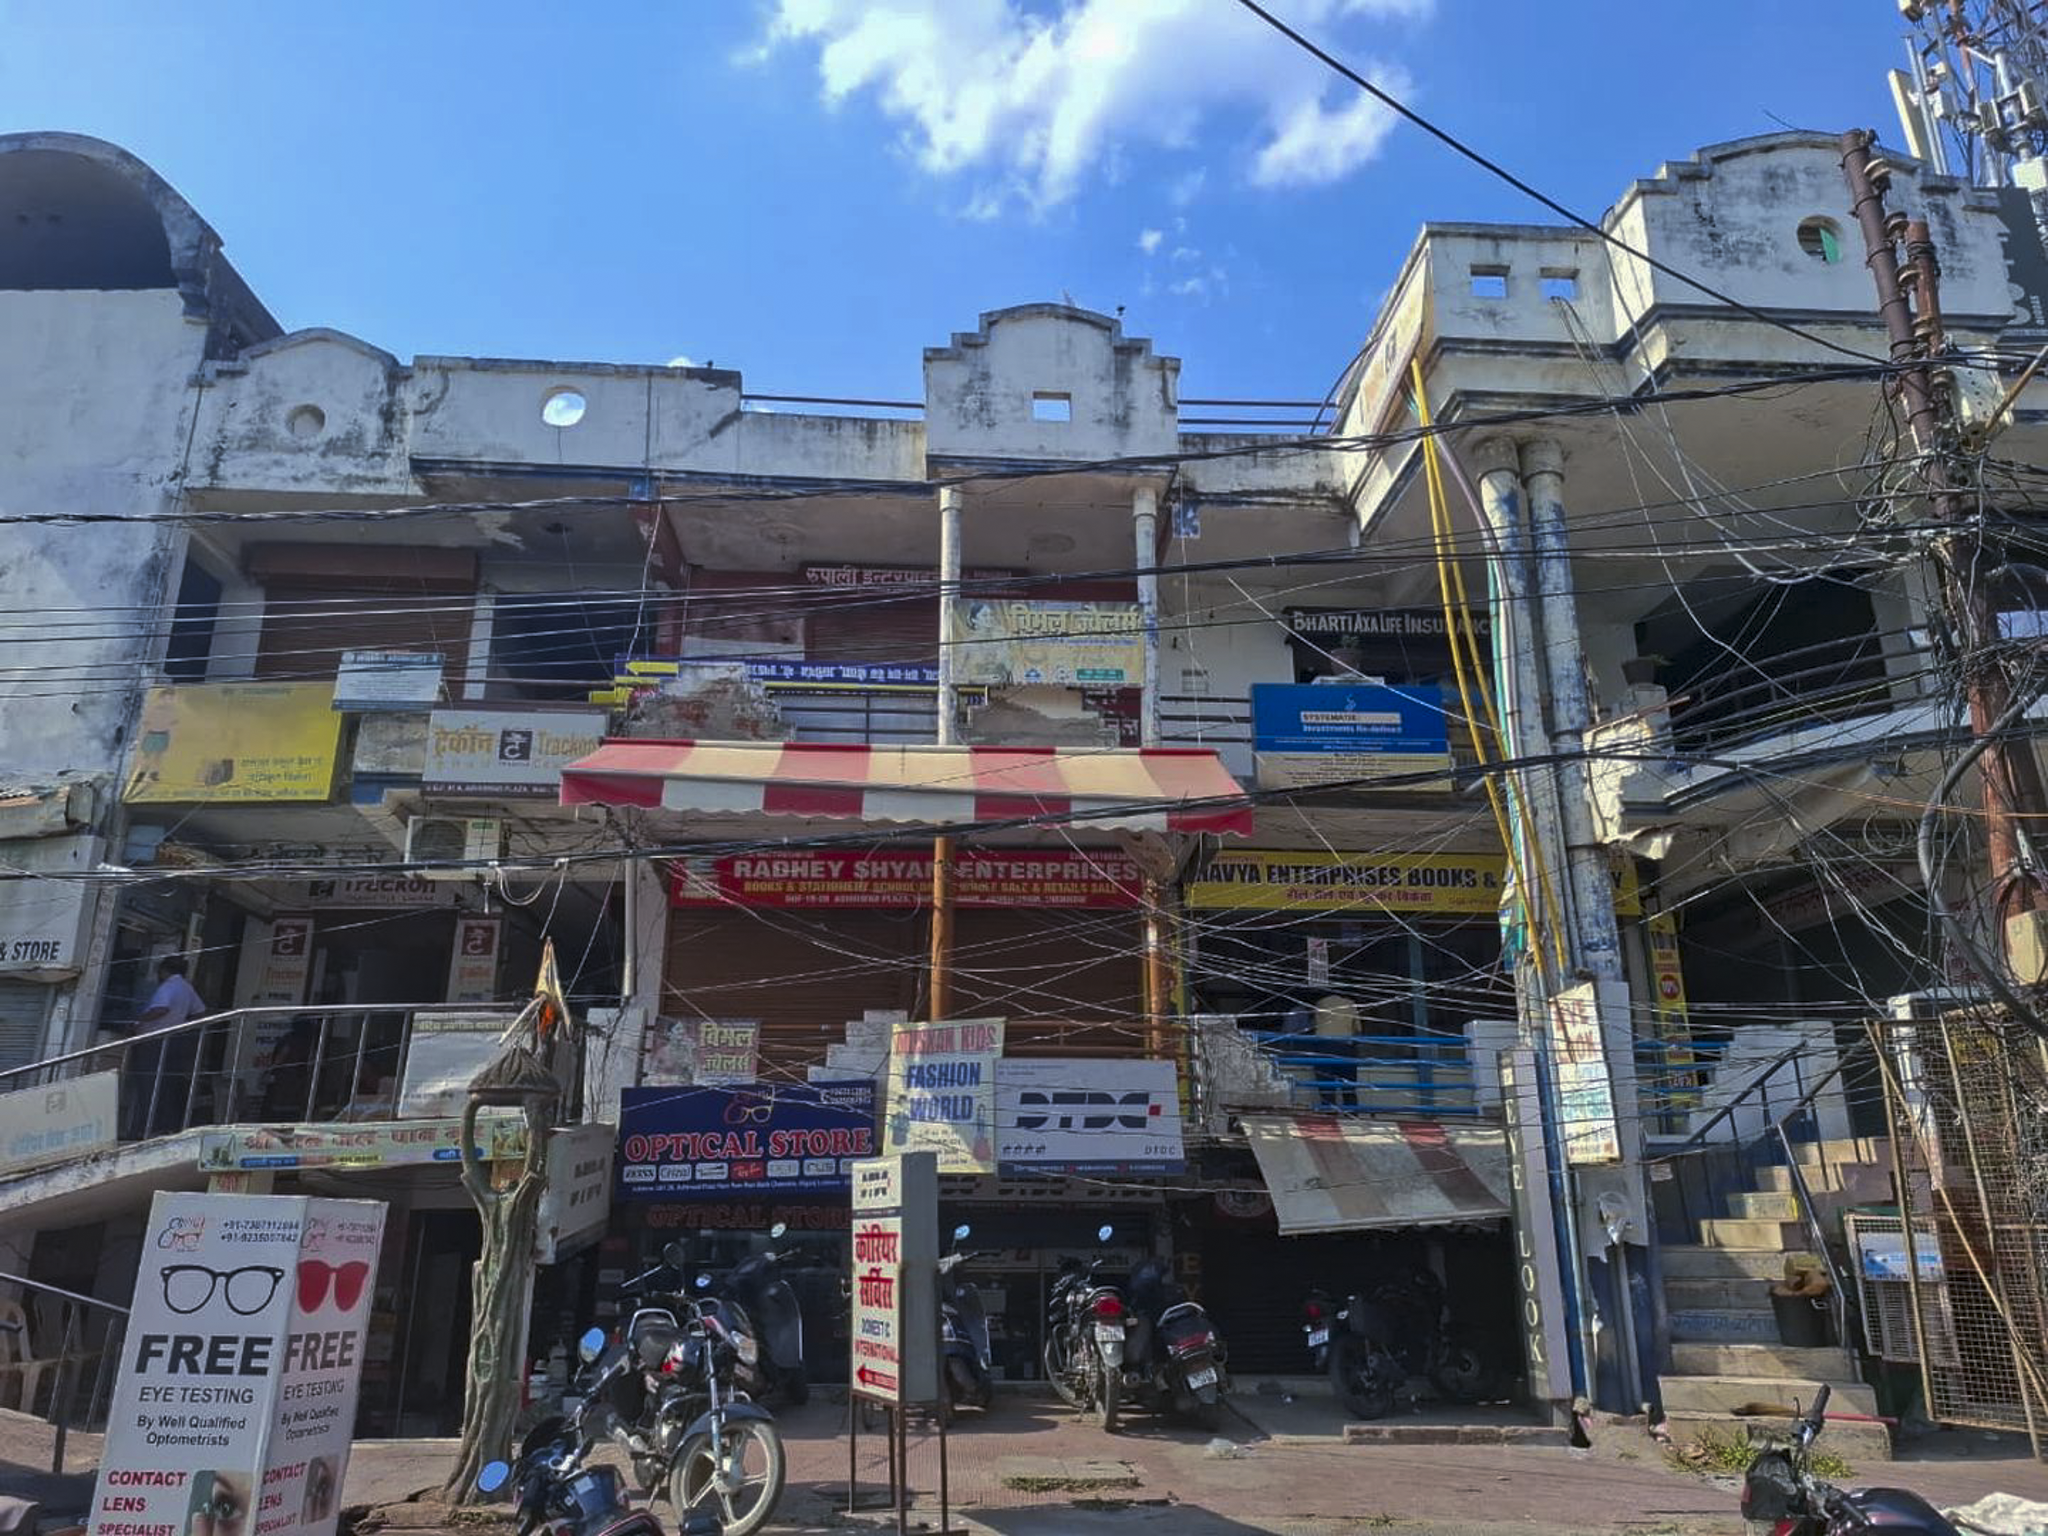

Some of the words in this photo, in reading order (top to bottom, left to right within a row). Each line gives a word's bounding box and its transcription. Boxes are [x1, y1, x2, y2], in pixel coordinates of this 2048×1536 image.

[1294, 611, 1351, 631] BHARTI
[1353, 613, 1378, 633] AXA
[1380, 613, 1402, 632] LIFE
[733, 860, 845, 879] RADHEY
[955, 861, 1139, 881] ENTERPRISES
[1267, 865, 1400, 886] ENTERPRISES
[1407, 868, 1478, 888] BOOKS
[1483, 871, 1497, 888] &
[12, 941, 61, 961] STORE
[961, 1024, 998, 1052] KIDS
[907, 1062, 981, 1089] FASHION
[910, 1095, 973, 1121] WORLD
[625, 1131, 764, 1163] OPTICAL
[769, 1126, 873, 1158] STORE
[1518, 1230, 1543, 1363] LOOK
[134, 1334, 274, 1376] FREE
[283, 1331, 358, 1374] FREE
[138, 1387, 175, 1403] EYE
[179, 1387, 254, 1404] TESTING
[283, 1384, 303, 1401] EYE
[305, 1378, 346, 1399] TESTING
[137, 1414, 153, 1429] By
[158, 1416, 186, 1430] Well
[189, 1416, 247, 1433] Qualified
[281, 1413, 292, 1426] By
[146, 1432, 230, 1447] Optometrists
[107, 1471, 188, 1487] CONTACT
[262, 1462, 308, 1485] CONTACT
[102, 1497, 147, 1512] LENS
[258, 1493, 283, 1512] LENS
[97, 1523, 176, 1536] SPECIALIST
